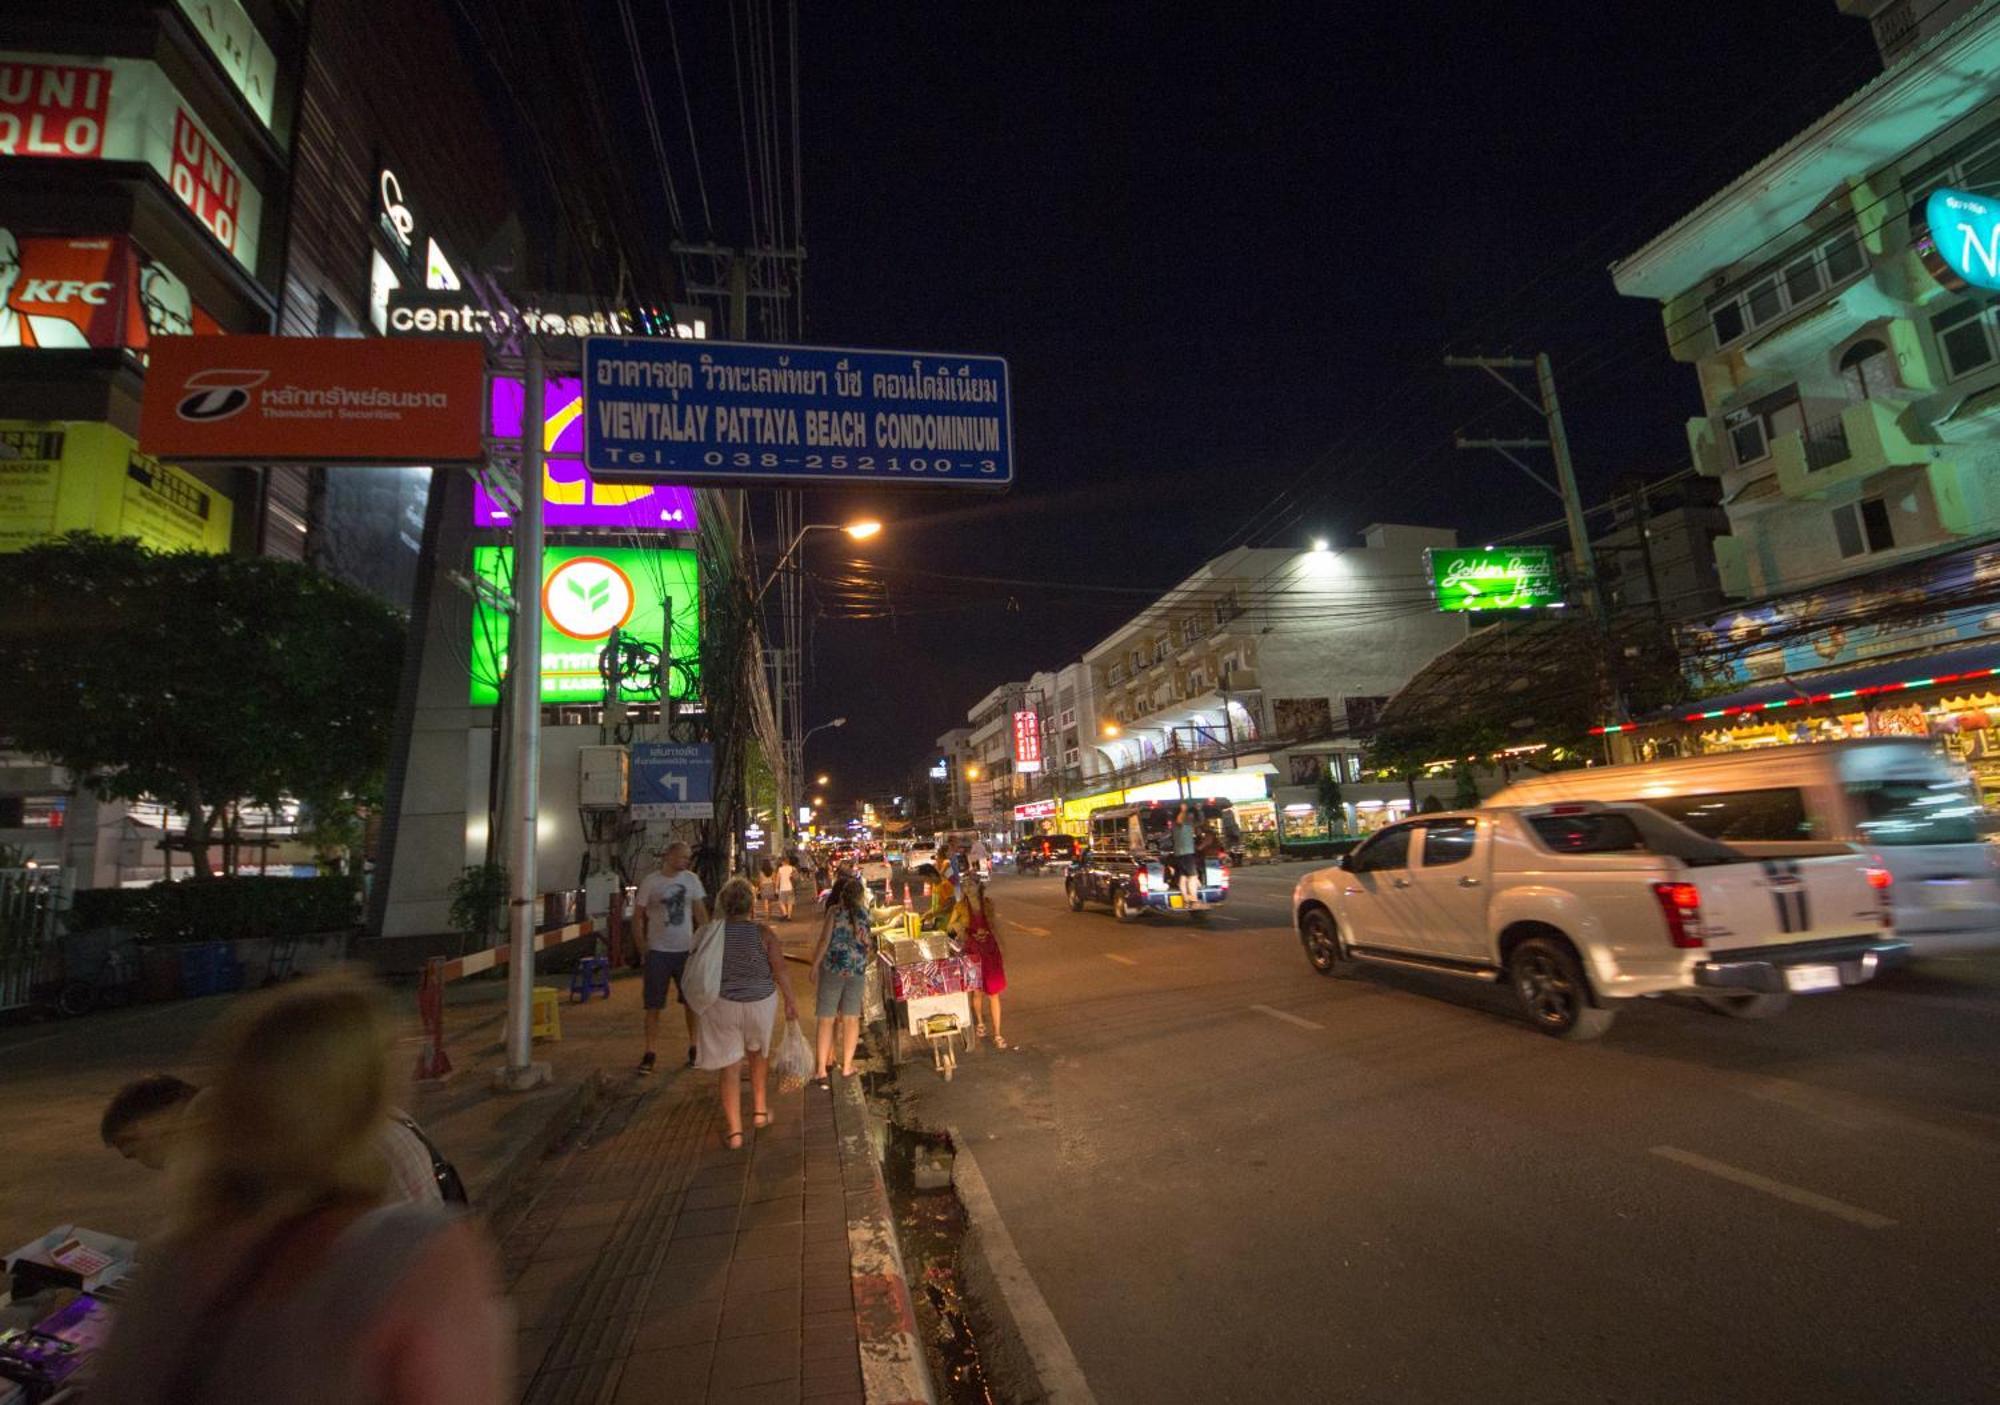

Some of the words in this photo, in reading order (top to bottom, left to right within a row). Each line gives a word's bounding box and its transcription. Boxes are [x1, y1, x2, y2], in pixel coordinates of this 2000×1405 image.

[0, 67, 100, 109] UNI
[180, 121, 238, 208] UNI
[19, 278, 113, 305] KFC
[597, 358, 694, 400] อาคารชุด
[599, 401, 710, 443] VIEWTALAY
[715, 406, 799, 445] PATTAYA
[805, 410, 867, 448] BEACH
[875, 411, 1000, 451] CONDOMINIUM
[605, 447, 677, 465] Tel.
[1441, 558, 1504, 588] Golden
[1506, 557, 1550, 577] Beach
